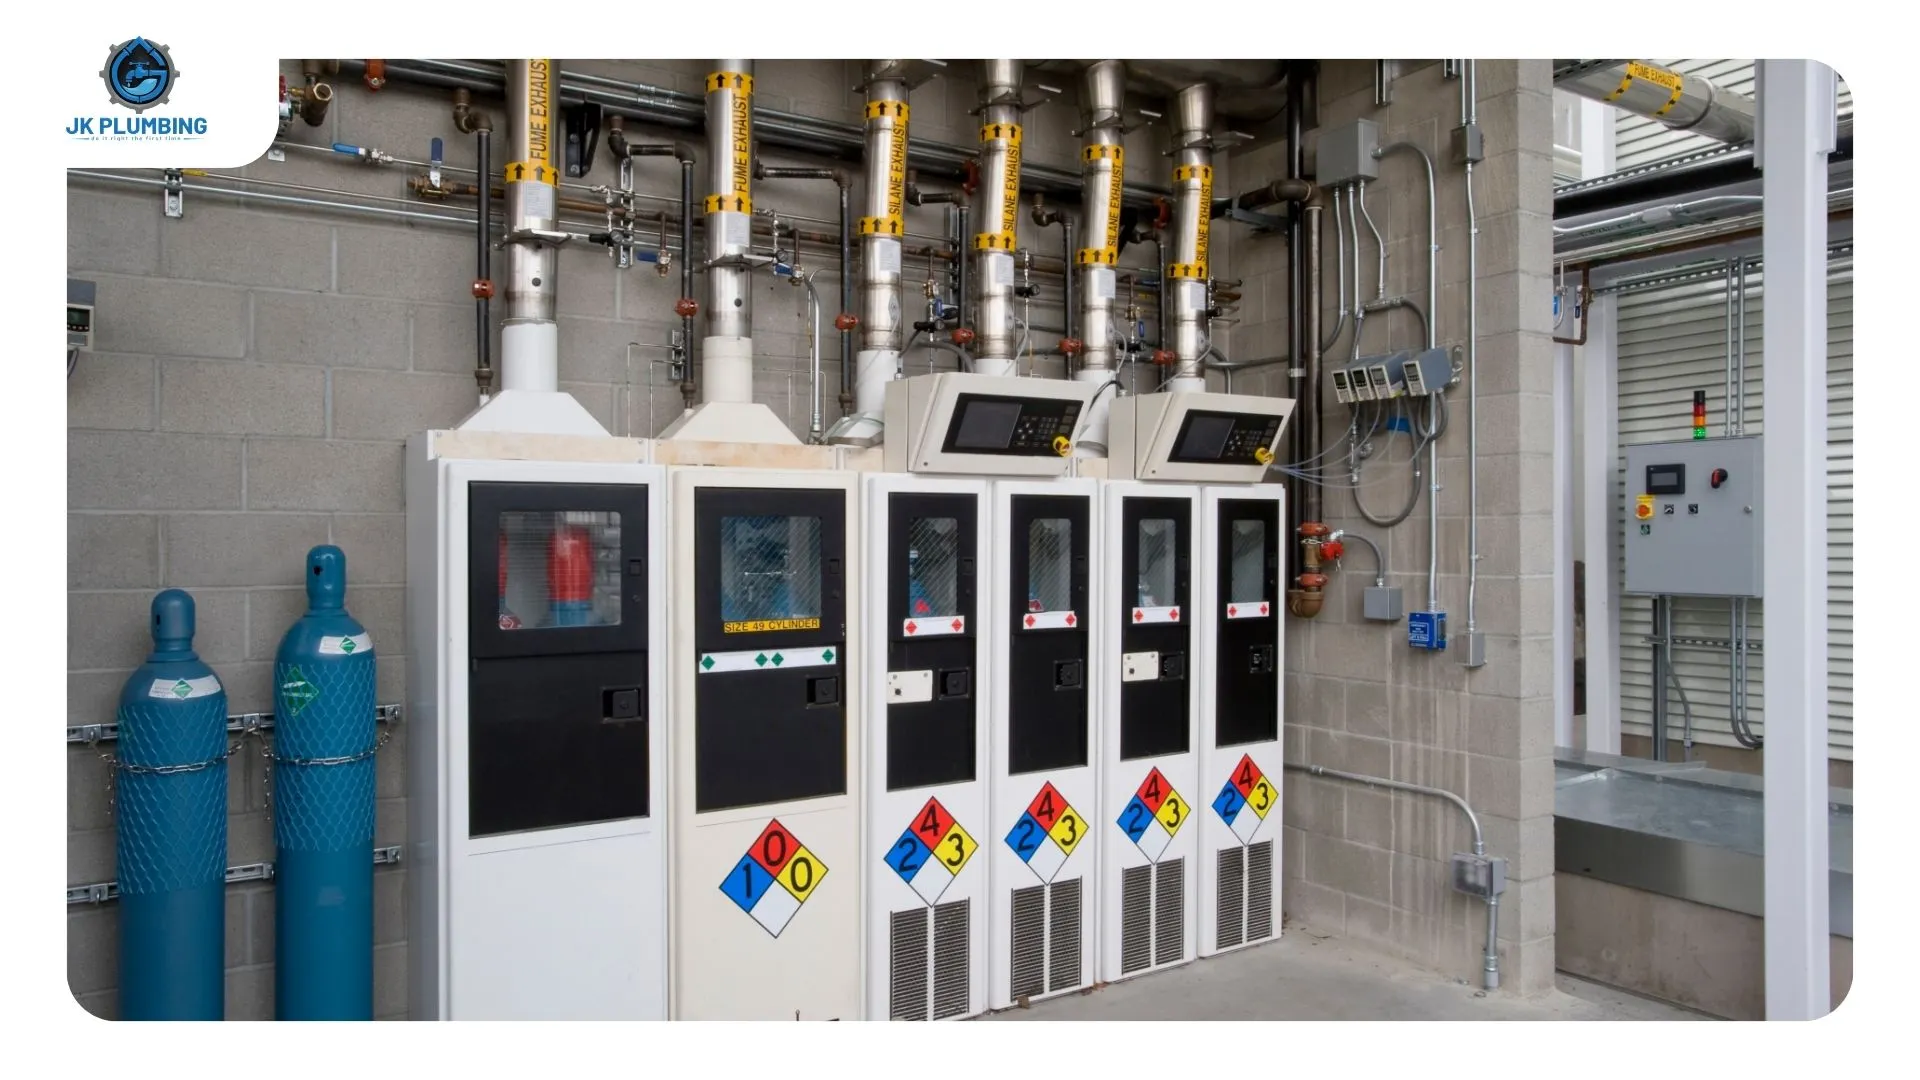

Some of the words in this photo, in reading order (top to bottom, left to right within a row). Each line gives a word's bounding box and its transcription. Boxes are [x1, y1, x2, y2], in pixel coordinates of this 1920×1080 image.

[530, 59, 547, 118] EXHAUS
[530, 121, 547, 160] FUME
[733, 93, 748, 153] EXHAUST
[890, 121, 905, 173] EXHAUST
[733, 156, 748, 193] FUME
[1005, 143, 1019, 191] EXHAUST
[888, 176, 902, 215] SILANE
[1109, 163, 1122, 209] EXHAUST
[1003, 194, 1015, 232] SILANE
[1199, 183, 1211, 226] EXHAUST
[1107, 212, 1119, 248] SILANE
[1196, 229, 1208, 262] SILANE
[725, 623, 748, 632] SIZE
[752, 621, 765, 630] 49
[769, 619, 818, 629] CYLINDER
[1144, 774, 1161, 803] 4
[1238, 761, 1253, 789] 4
[1036, 790, 1055, 822] 4
[1166, 798, 1180, 828] 3
[1222, 787, 1236, 817] 2
[1256, 782, 1269, 811] 3
[920, 804, 940, 837] 4
[1017, 819, 1035, 853] 2
[1061, 814, 1077, 847] 3
[1127, 803, 1144, 834] 2
[763, 830, 786, 867] 0
[898, 837, 918, 873] 2
[946, 832, 965, 867] 3
[742, 862, 752, 899] 1
[790, 857, 813, 893] 0
